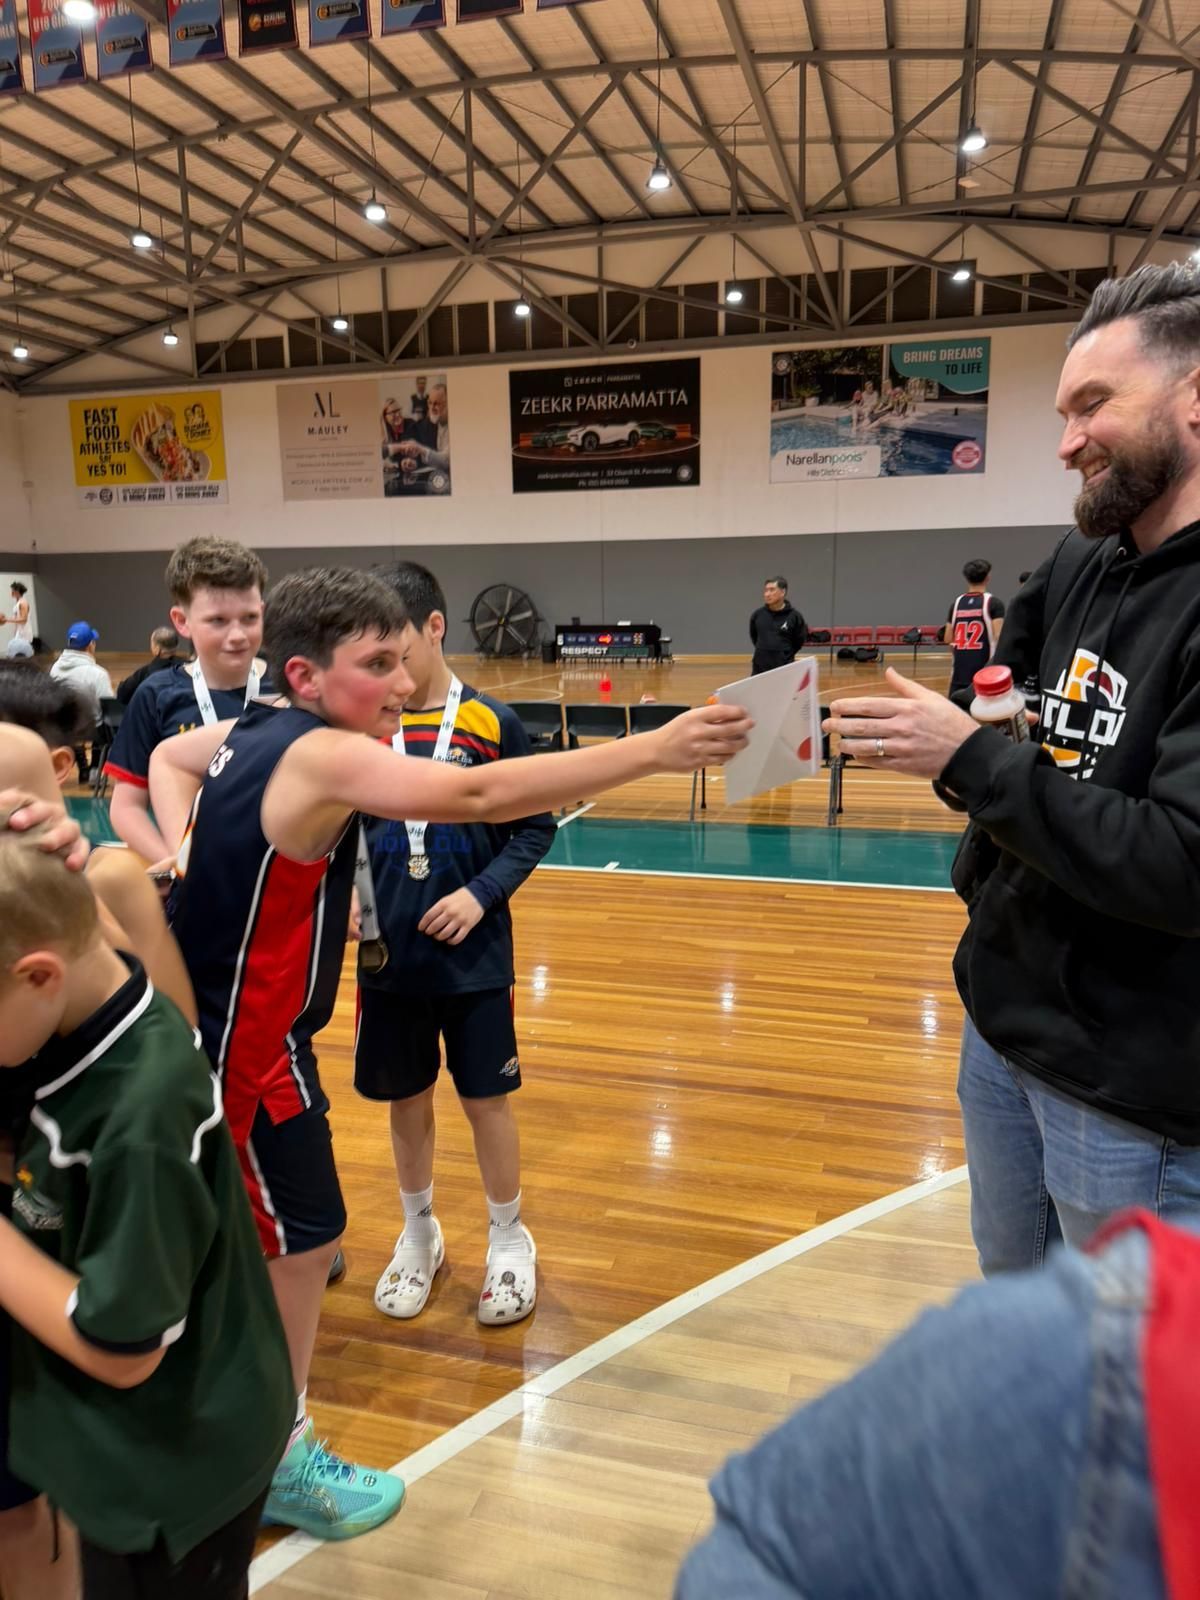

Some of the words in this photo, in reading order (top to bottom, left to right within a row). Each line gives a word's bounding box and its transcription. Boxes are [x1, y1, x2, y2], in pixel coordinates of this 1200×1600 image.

[903, 349, 937, 363] BRING
[939, 346, 984, 361] DREAMS
[945, 363, 958, 375] TO
[961, 361, 983, 374] LIFE
[520, 395, 572, 416] ZEEKR
[576, 389, 689, 412] PARRAMATTA
[83, 407, 118, 425] FAST
[85, 425, 120, 442] FOOD
[79, 440, 131, 456] ATHLETES
[785, 452, 863, 466] Narellanpools
[87, 464, 107, 477] YES
[109, 463, 127, 476] TO!
[953, 620, 984, 650] 42
[560, 646, 608, 655] RESPECT
